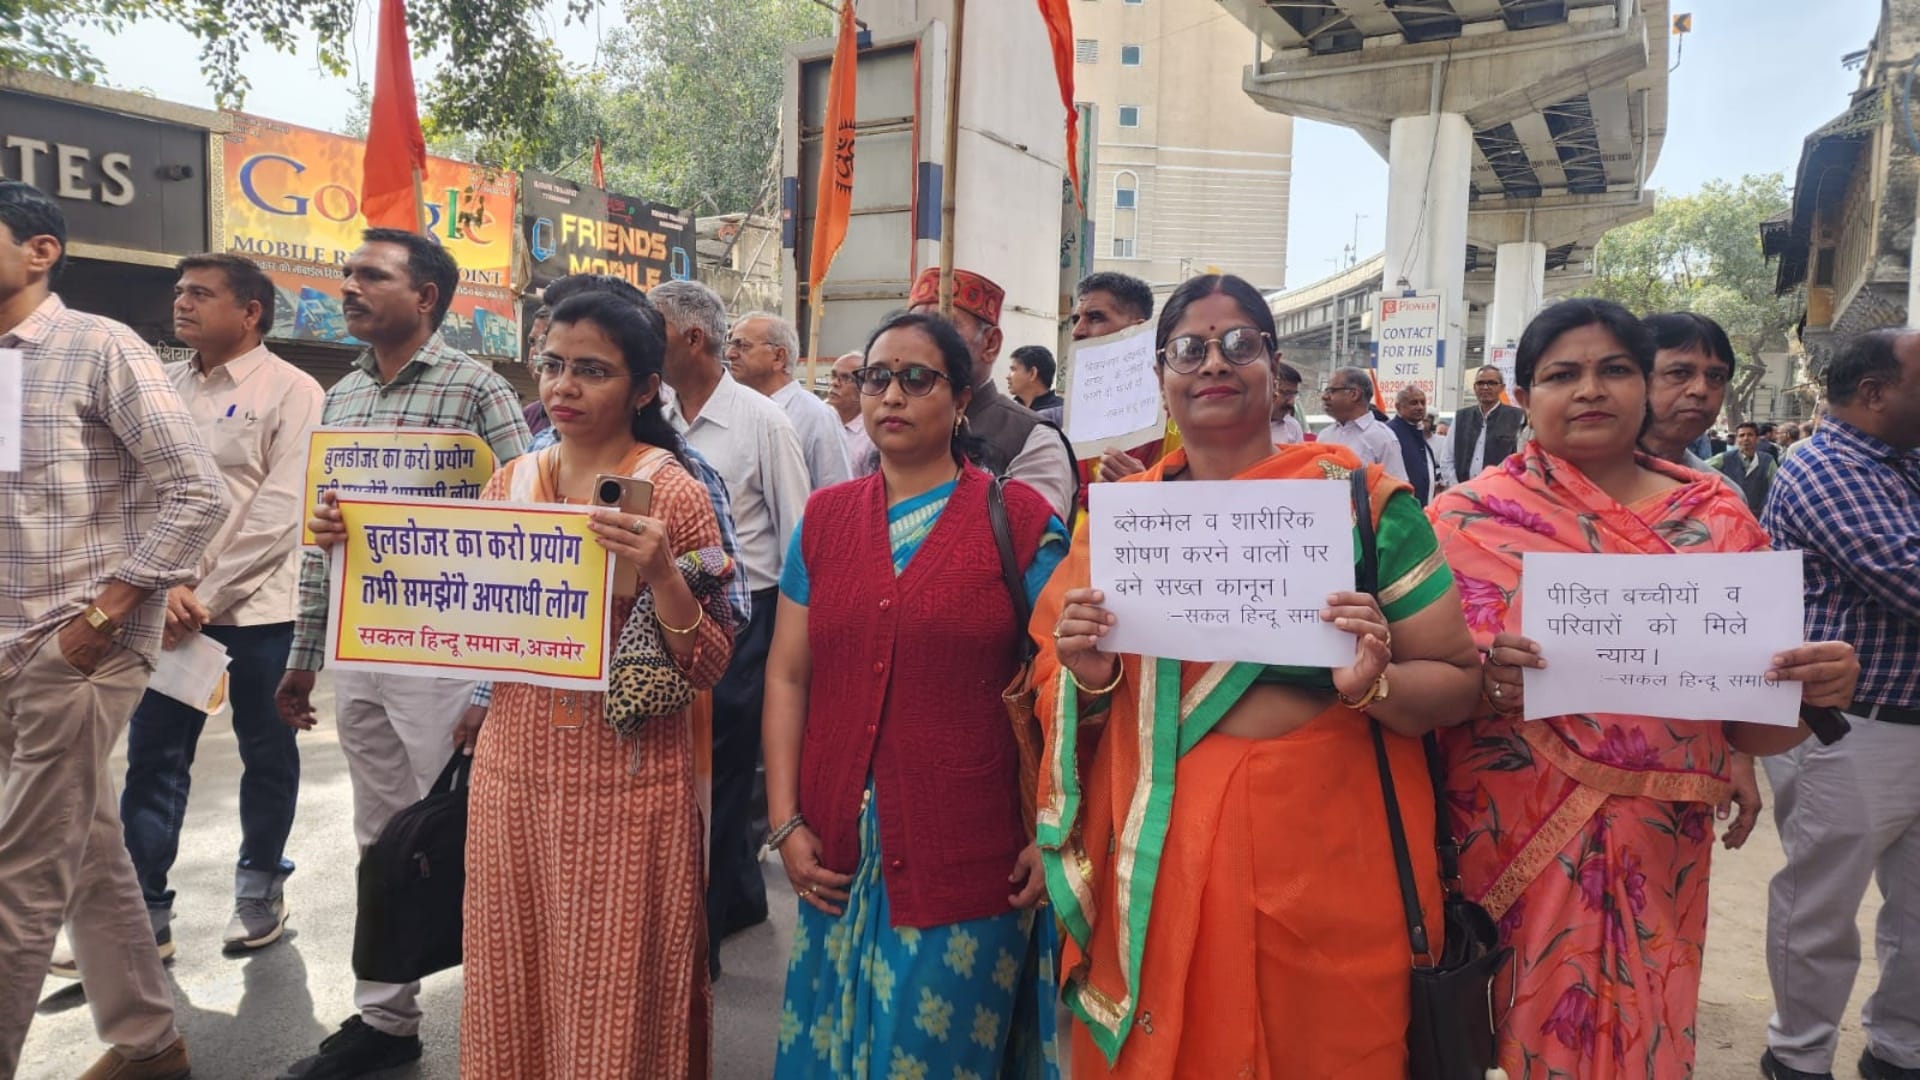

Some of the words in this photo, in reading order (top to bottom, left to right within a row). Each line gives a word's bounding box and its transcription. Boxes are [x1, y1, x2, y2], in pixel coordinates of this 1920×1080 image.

[0, 135, 135, 206] TES
[232, 235, 326, 264] MOBILE
[561, 213, 667, 261] FRIENDS
[457, 267, 503, 284] OINT
[1383, 327, 1434, 340] CONTACT
[1382, 346, 1405, 357] FOR
[1408, 345, 1433, 357] THIS
[1395, 363, 1419, 375] SITE
[324, 442, 380, 474] बुलडोजर
[382, 448, 401, 469] का
[404, 443, 431, 470] करो
[434, 444, 475, 471] प्रयोग
[1113, 508, 1192, 532] ब्लैकमेल
[1203, 513, 1218, 531] व
[1230, 505, 1315, 530] शारीरिक
[364, 518, 450, 563] बुलडोजर
[453, 528, 483, 558] का
[486, 524, 525, 561] करो
[529, 526, 583, 565] प्रयोग
[1114, 541, 1170, 564] शोषण
[1181, 539, 1229, 564] करने
[1242, 538, 1290, 564] वालों
[1303, 544, 1329, 563] पर
[361, 570, 398, 605] तभी
[401, 572, 469, 613] समझेंगे
[473, 578, 543, 616] अपराधी
[545, 580, 588, 620] लोग
[1114, 572, 1143, 597] बने
[1154, 578, 1203, 597] सख्त
[1546, 582, 1610, 608] पीड़ित
[1622, 581, 1700, 605] बच्चीयों
[1724, 586, 1742, 604] व
[1240, 604, 1281, 629] हिन्दू
[1286, 608, 1320, 624] समा
[1546, 613, 1622, 636] परिवारों
[1648, 613, 1678, 635] को
[1704, 612, 1748, 635] मिले
[358, 627, 416, 648] सकल
[420, 625, 463, 658] हिन्दू
[1679, 670, 1719, 692] हिन्दू
